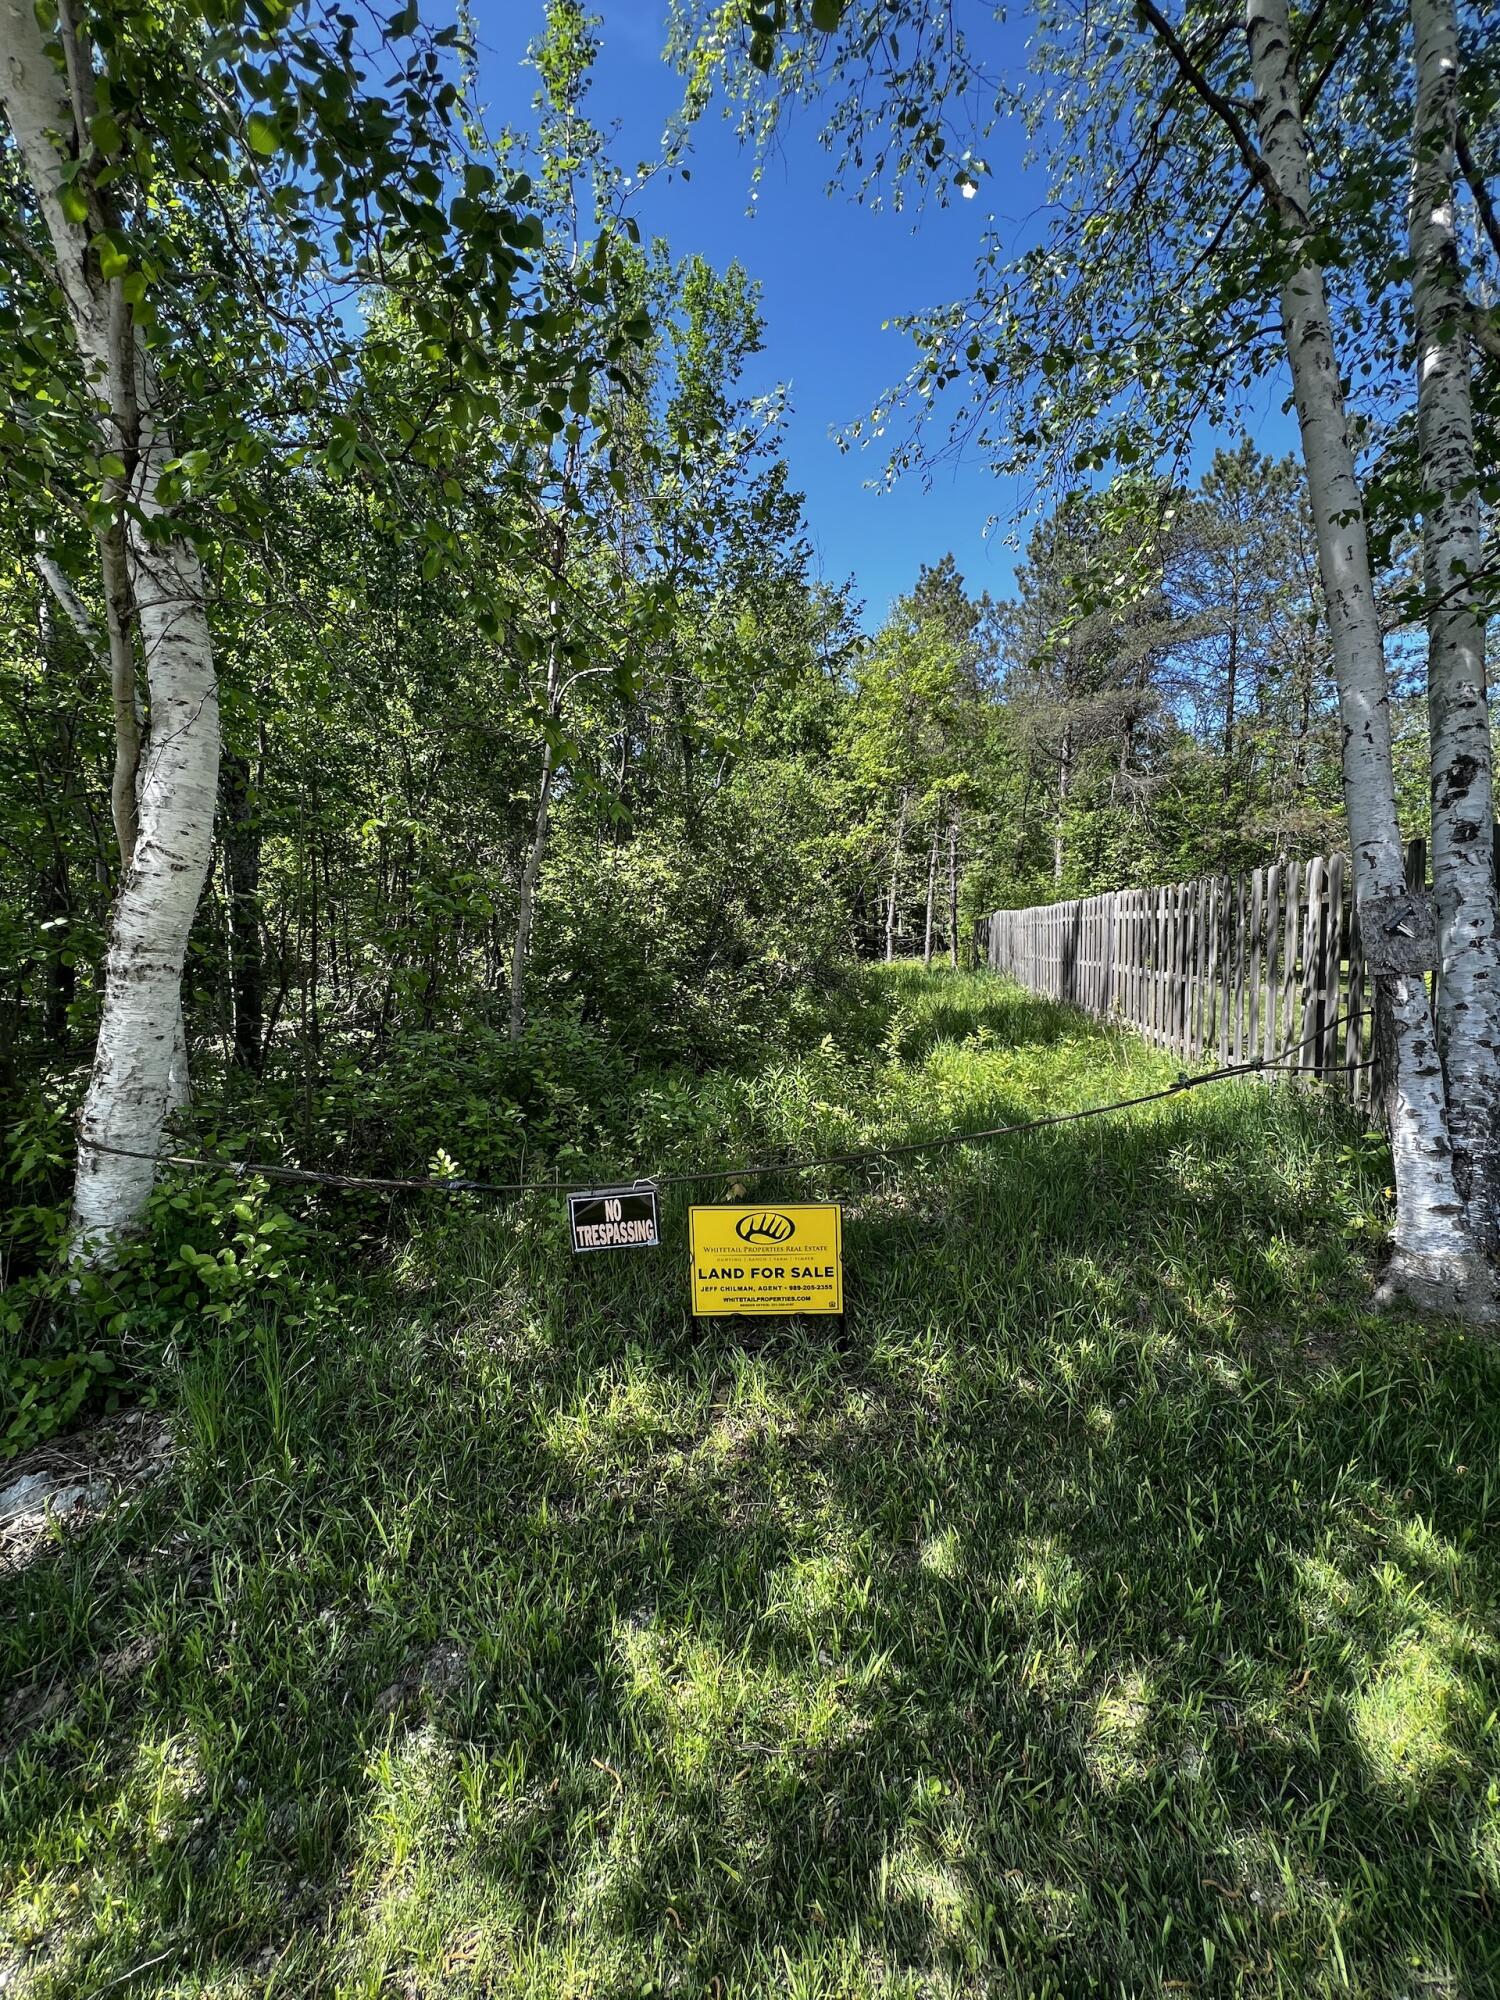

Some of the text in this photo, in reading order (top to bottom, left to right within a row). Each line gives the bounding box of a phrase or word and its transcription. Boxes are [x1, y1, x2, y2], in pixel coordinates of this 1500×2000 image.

[604, 1198, 622, 1222] NO
[576, 1218, 655, 1246] TRESPASSING
[698, 1266, 835, 1279] LAND FOR SALE
[700, 1285, 718, 1293] JEFF
